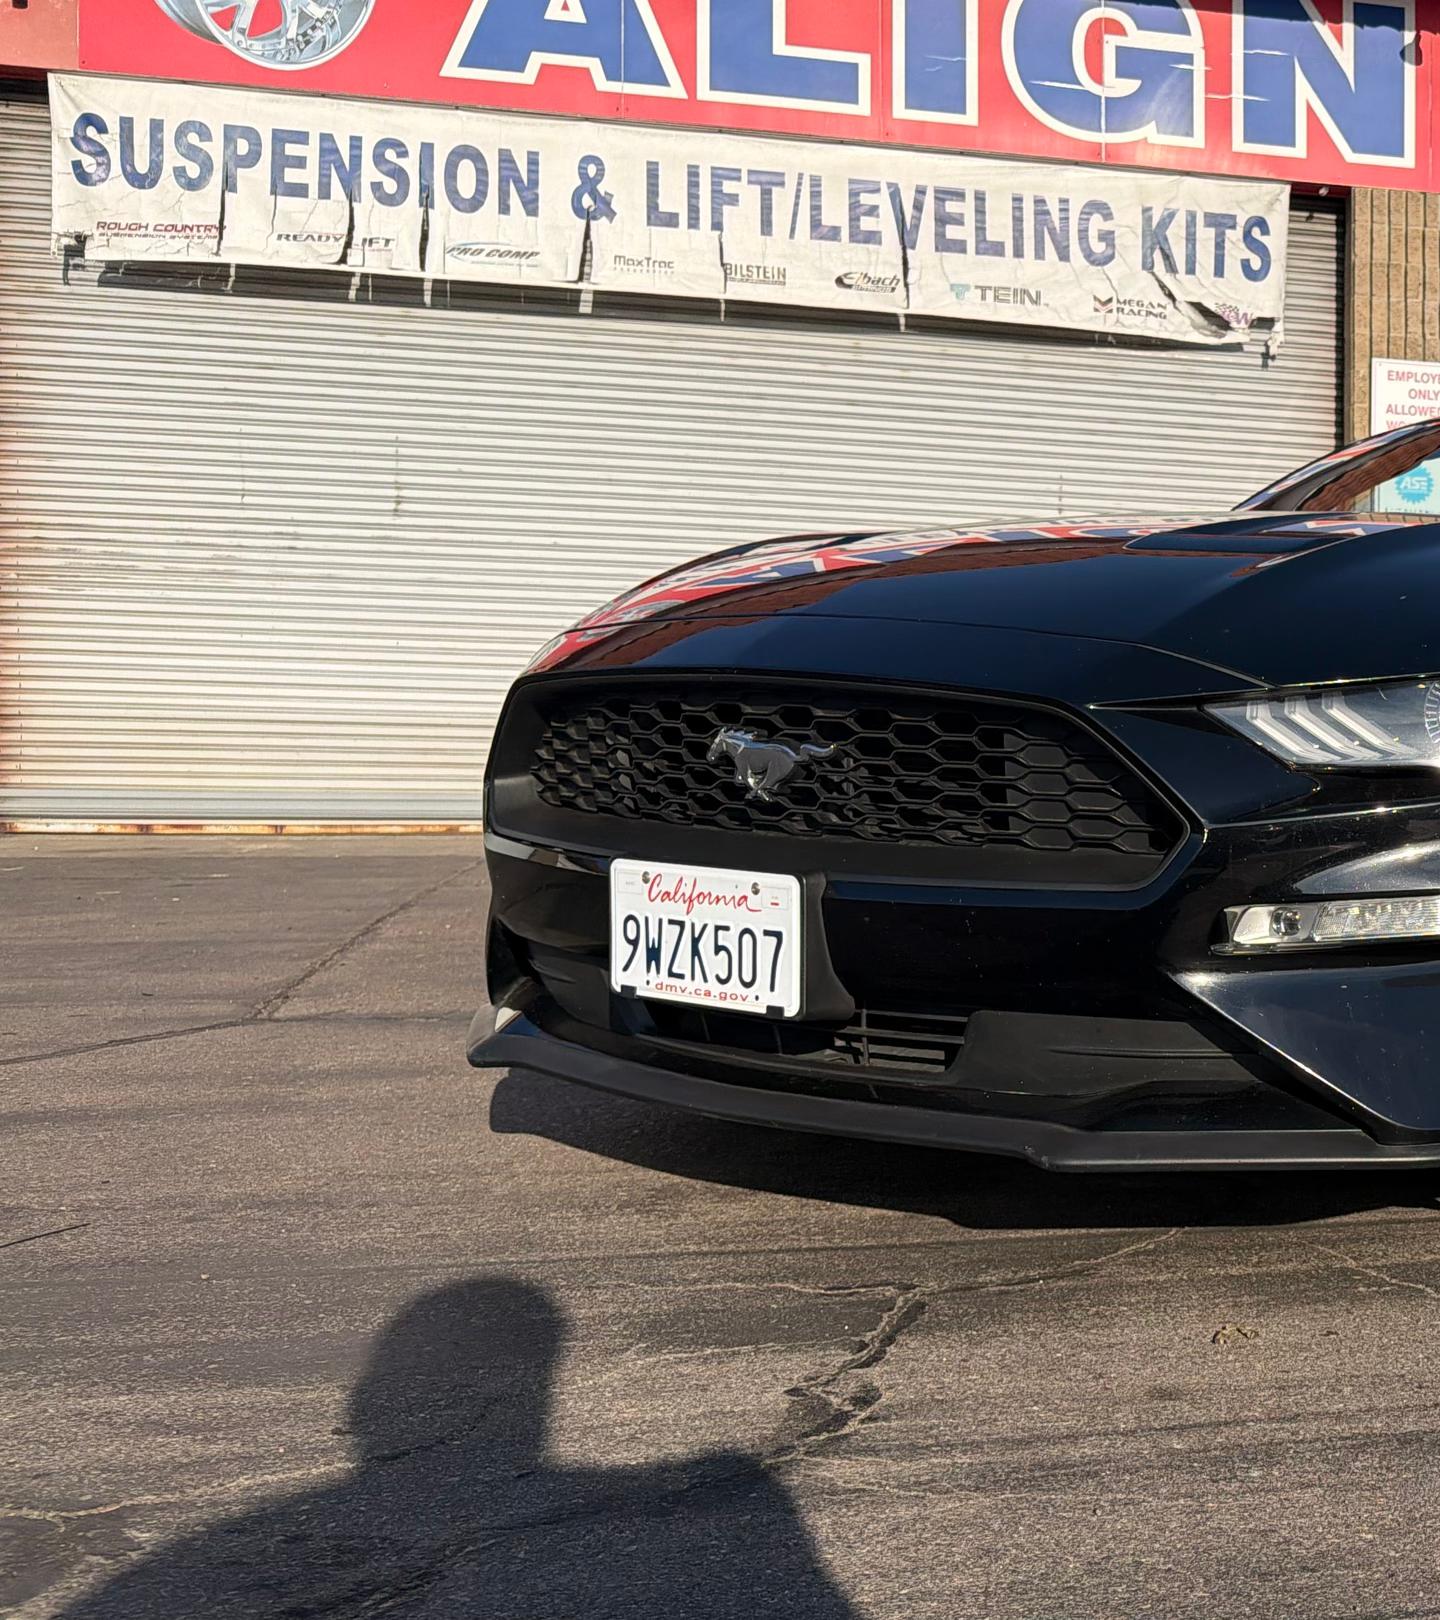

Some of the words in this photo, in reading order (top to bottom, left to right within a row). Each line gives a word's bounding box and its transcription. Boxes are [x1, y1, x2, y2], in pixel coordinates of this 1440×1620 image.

[69, 112, 540, 217] SUSPENSION
[571, 155, 617, 225] &
[646, 160, 1116, 268] LIFT/LEVELING
[1141, 206, 1272, 283] KITS
[96, 221, 149, 233] ROUGH
[153, 223, 227, 235] COUNTRY
[447, 247, 484, 257] PRO
[485, 248, 541, 260] COMP
[724, 263, 786, 281] BILSTEIN
[974, 284, 1042, 307] TEIN
[1116, 299, 1167, 311] MEGAN
[1116, 307, 1167, 320] RACING
[1408, 388, 1440, 401] ONLY
[1400, 476, 1428, 490] ASE
[648, 873, 762, 915] California
[622, 913, 784, 992] 9WZK507
[655, 981, 750, 1002] dmv.ca.gov
